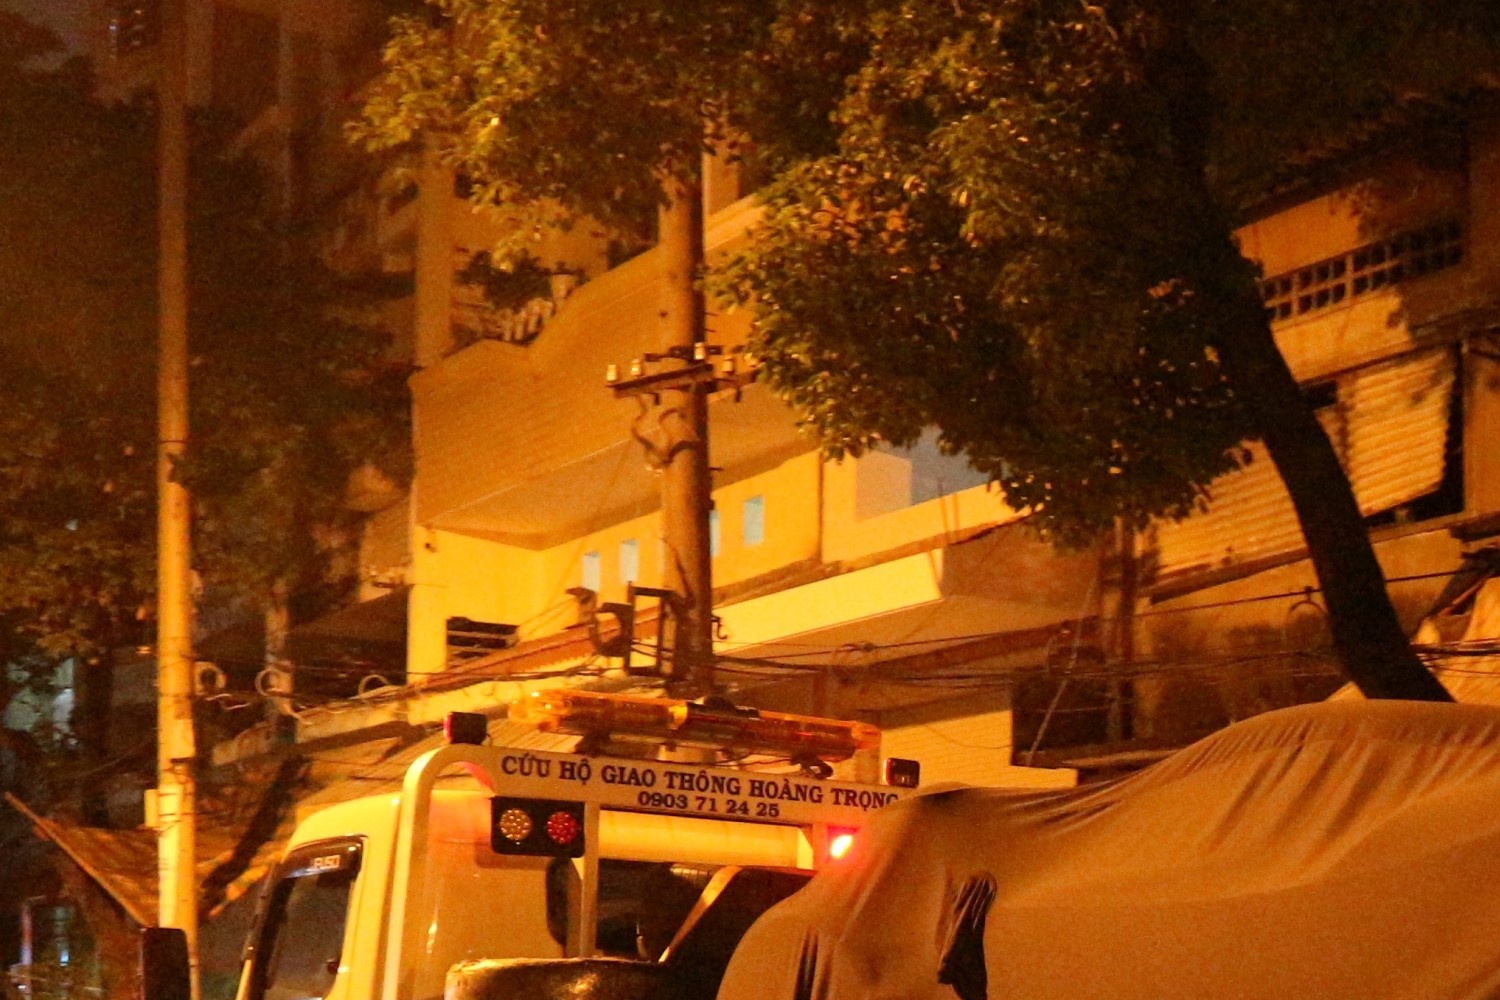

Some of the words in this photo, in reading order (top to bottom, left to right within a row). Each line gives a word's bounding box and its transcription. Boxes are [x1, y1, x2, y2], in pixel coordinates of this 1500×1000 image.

[502, 753, 551, 778] CỨU
[559, 758, 592, 785] HỘ
[601, 765, 656, 788] GIAO
[664, 769, 741, 796] THÔNG
[749, 778, 823, 804] HOÀNG
[638, 791, 689, 810] 0903
[696, 796, 717, 812] 71
[726, 799, 749, 815] 24
[756, 801, 779, 818] 25
